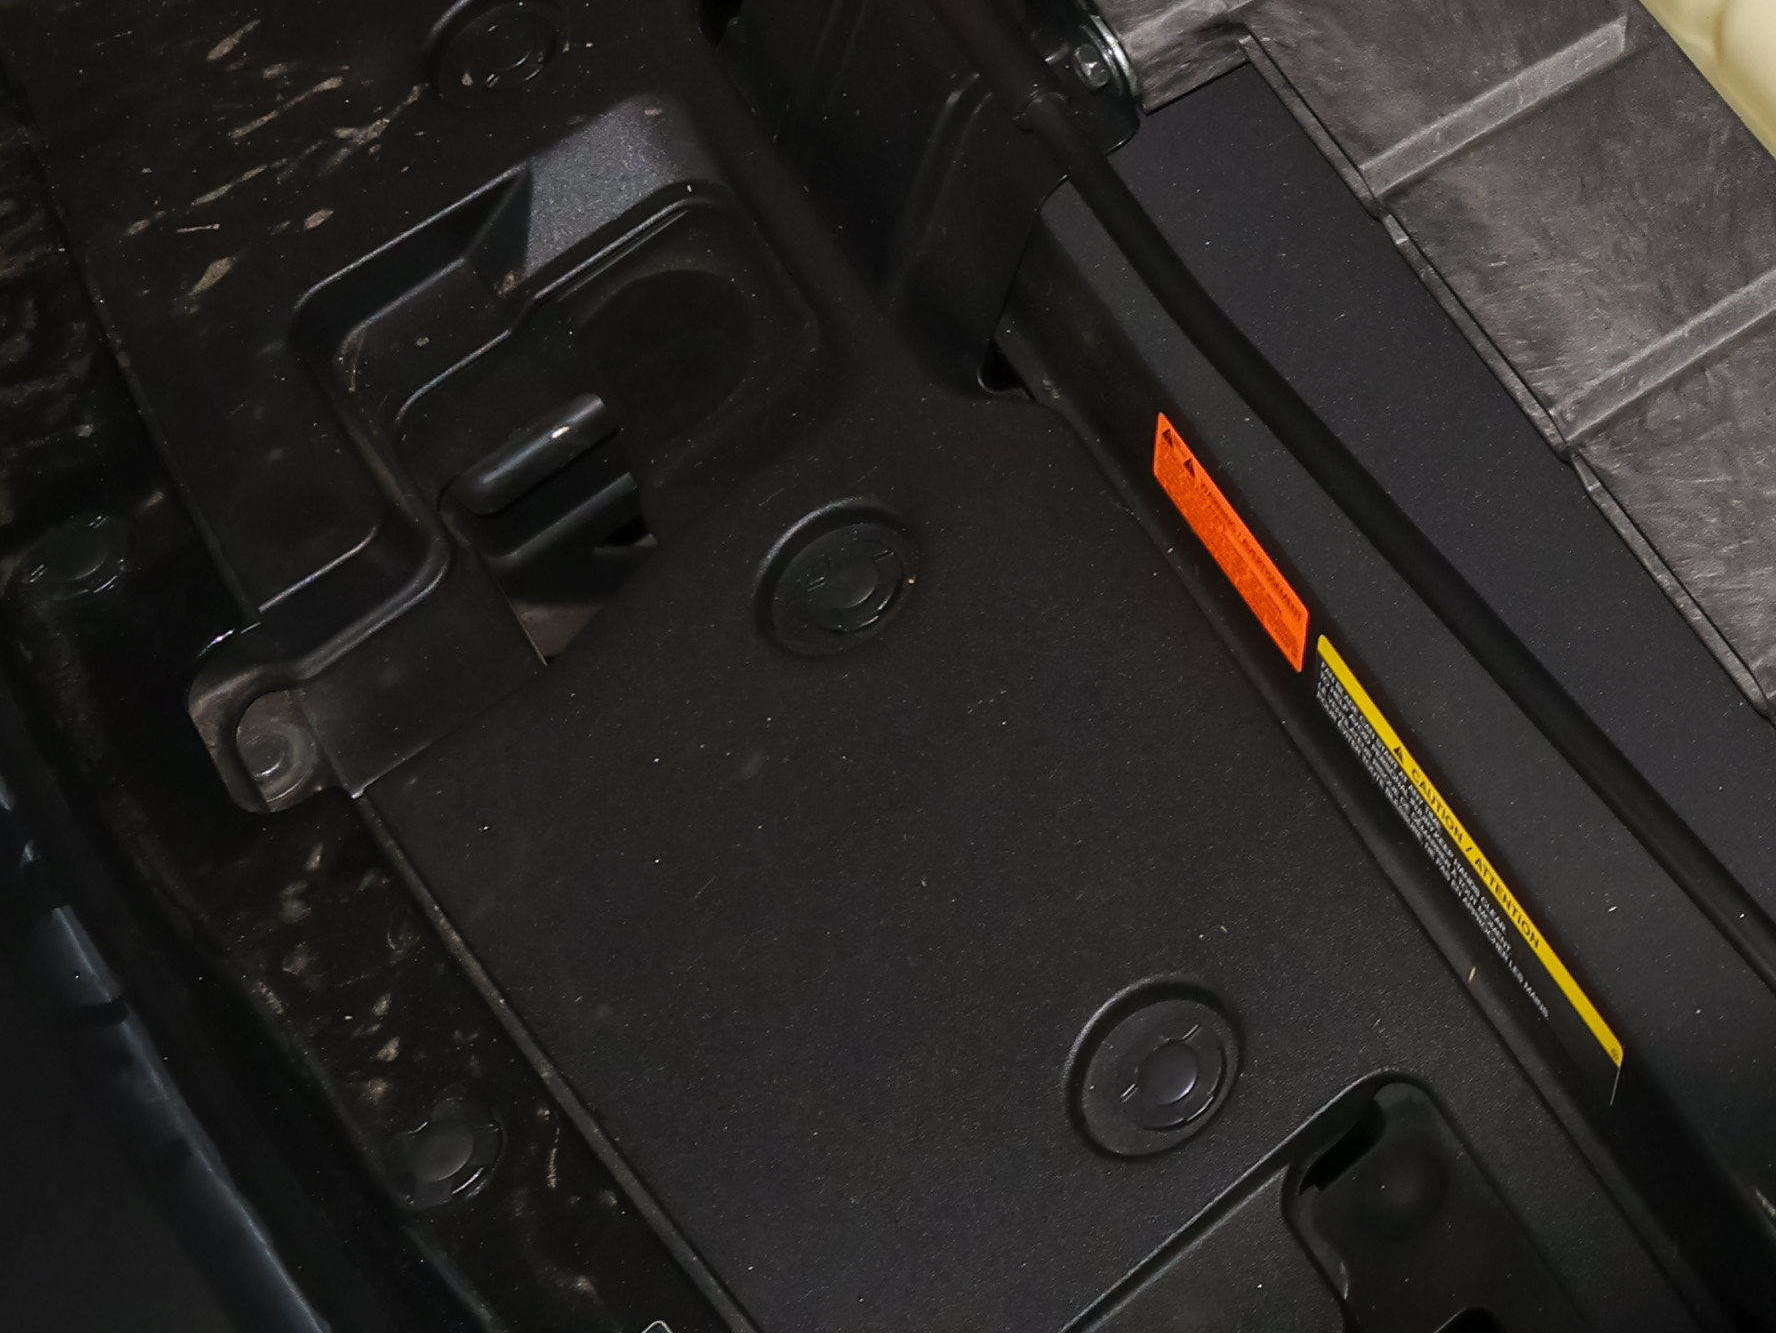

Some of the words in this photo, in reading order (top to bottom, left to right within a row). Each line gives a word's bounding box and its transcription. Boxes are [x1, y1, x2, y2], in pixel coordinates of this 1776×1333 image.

[1318, 670, 1331, 689] TO
[1329, 685, 1349, 715] HELP
[1347, 711, 1371, 746] AVOID
[1451, 857, 1480, 898] HANDS
[1357, 713, 1376, 740] CAN
[1410, 766, 1464, 844] CAUTION
[1464, 843, 1472, 855] /
[1473, 855, 1539, 950] ATTENTION
